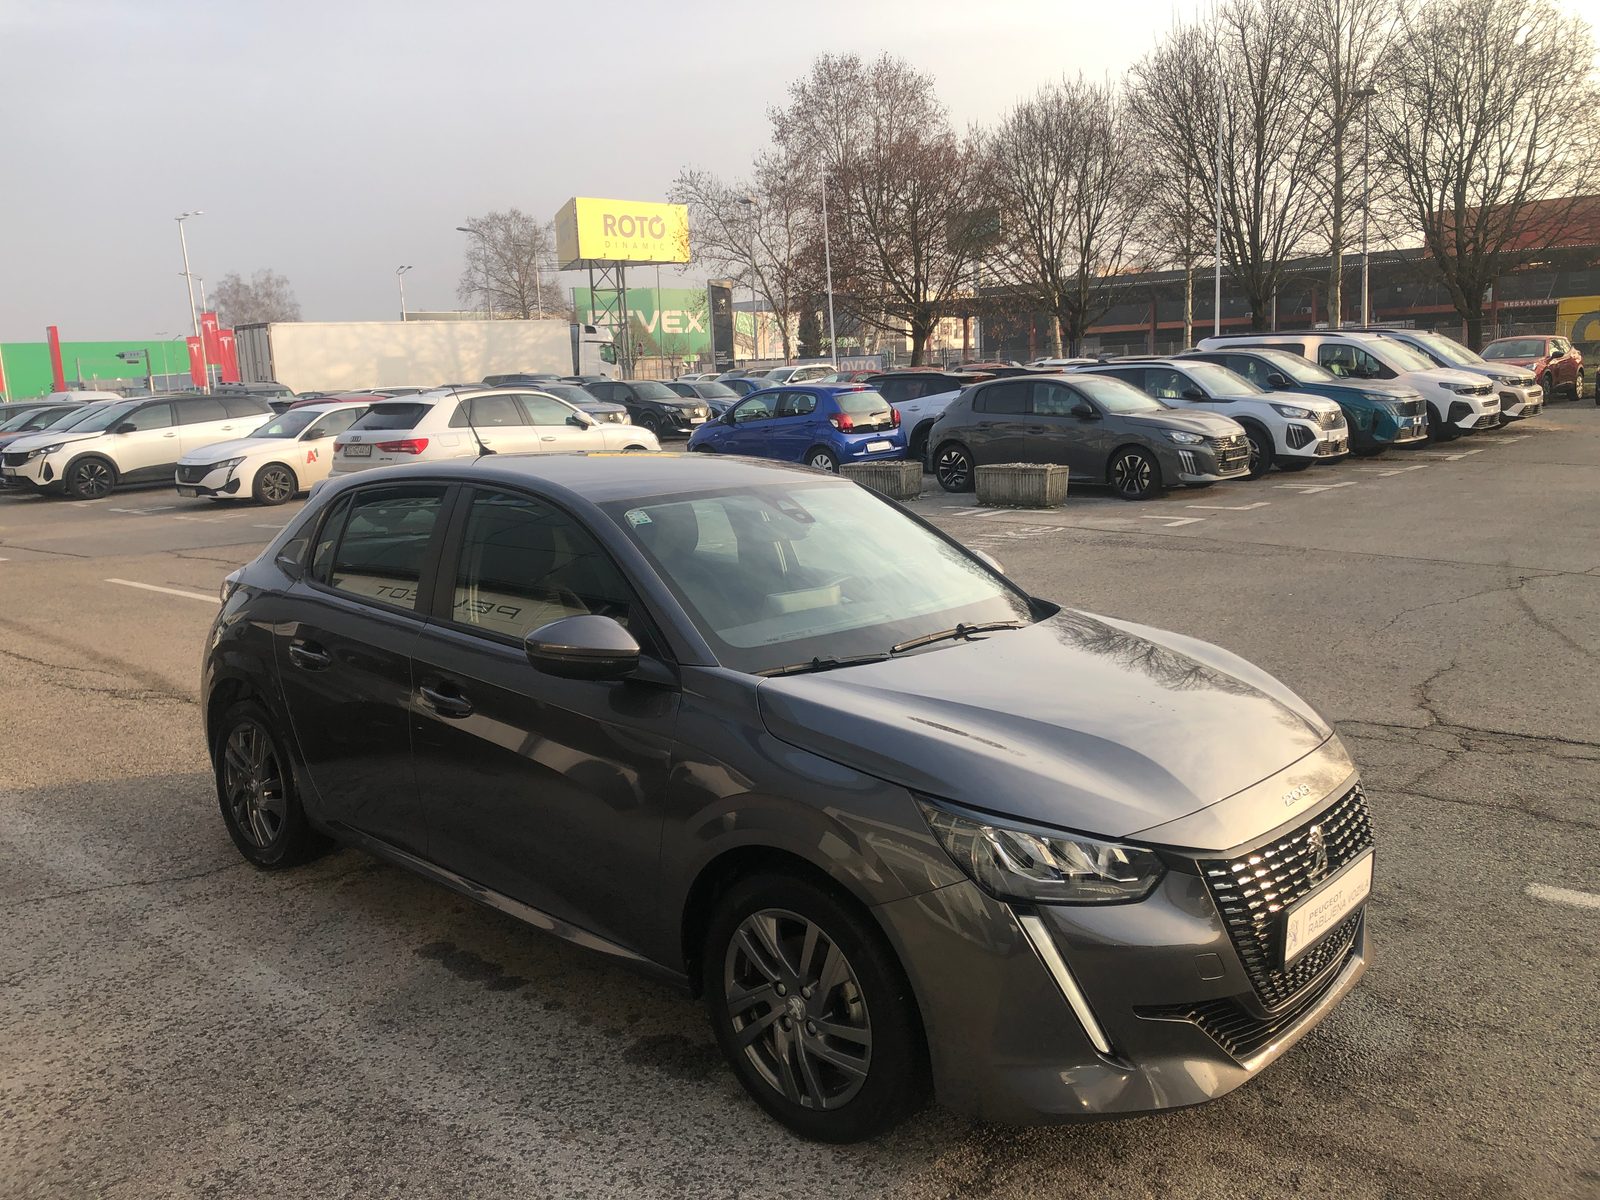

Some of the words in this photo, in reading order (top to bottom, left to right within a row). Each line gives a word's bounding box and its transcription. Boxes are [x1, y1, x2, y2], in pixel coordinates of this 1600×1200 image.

[603, 214, 666, 240] ROTO
[604, 240, 665, 251] DINAMIC
[1503, 299, 1559, 308] RESTAURANT
[306, 448, 319, 464] A1
[1281, 783, 1312, 807] 208
[1308, 890, 1343, 922] PEUGEOT
